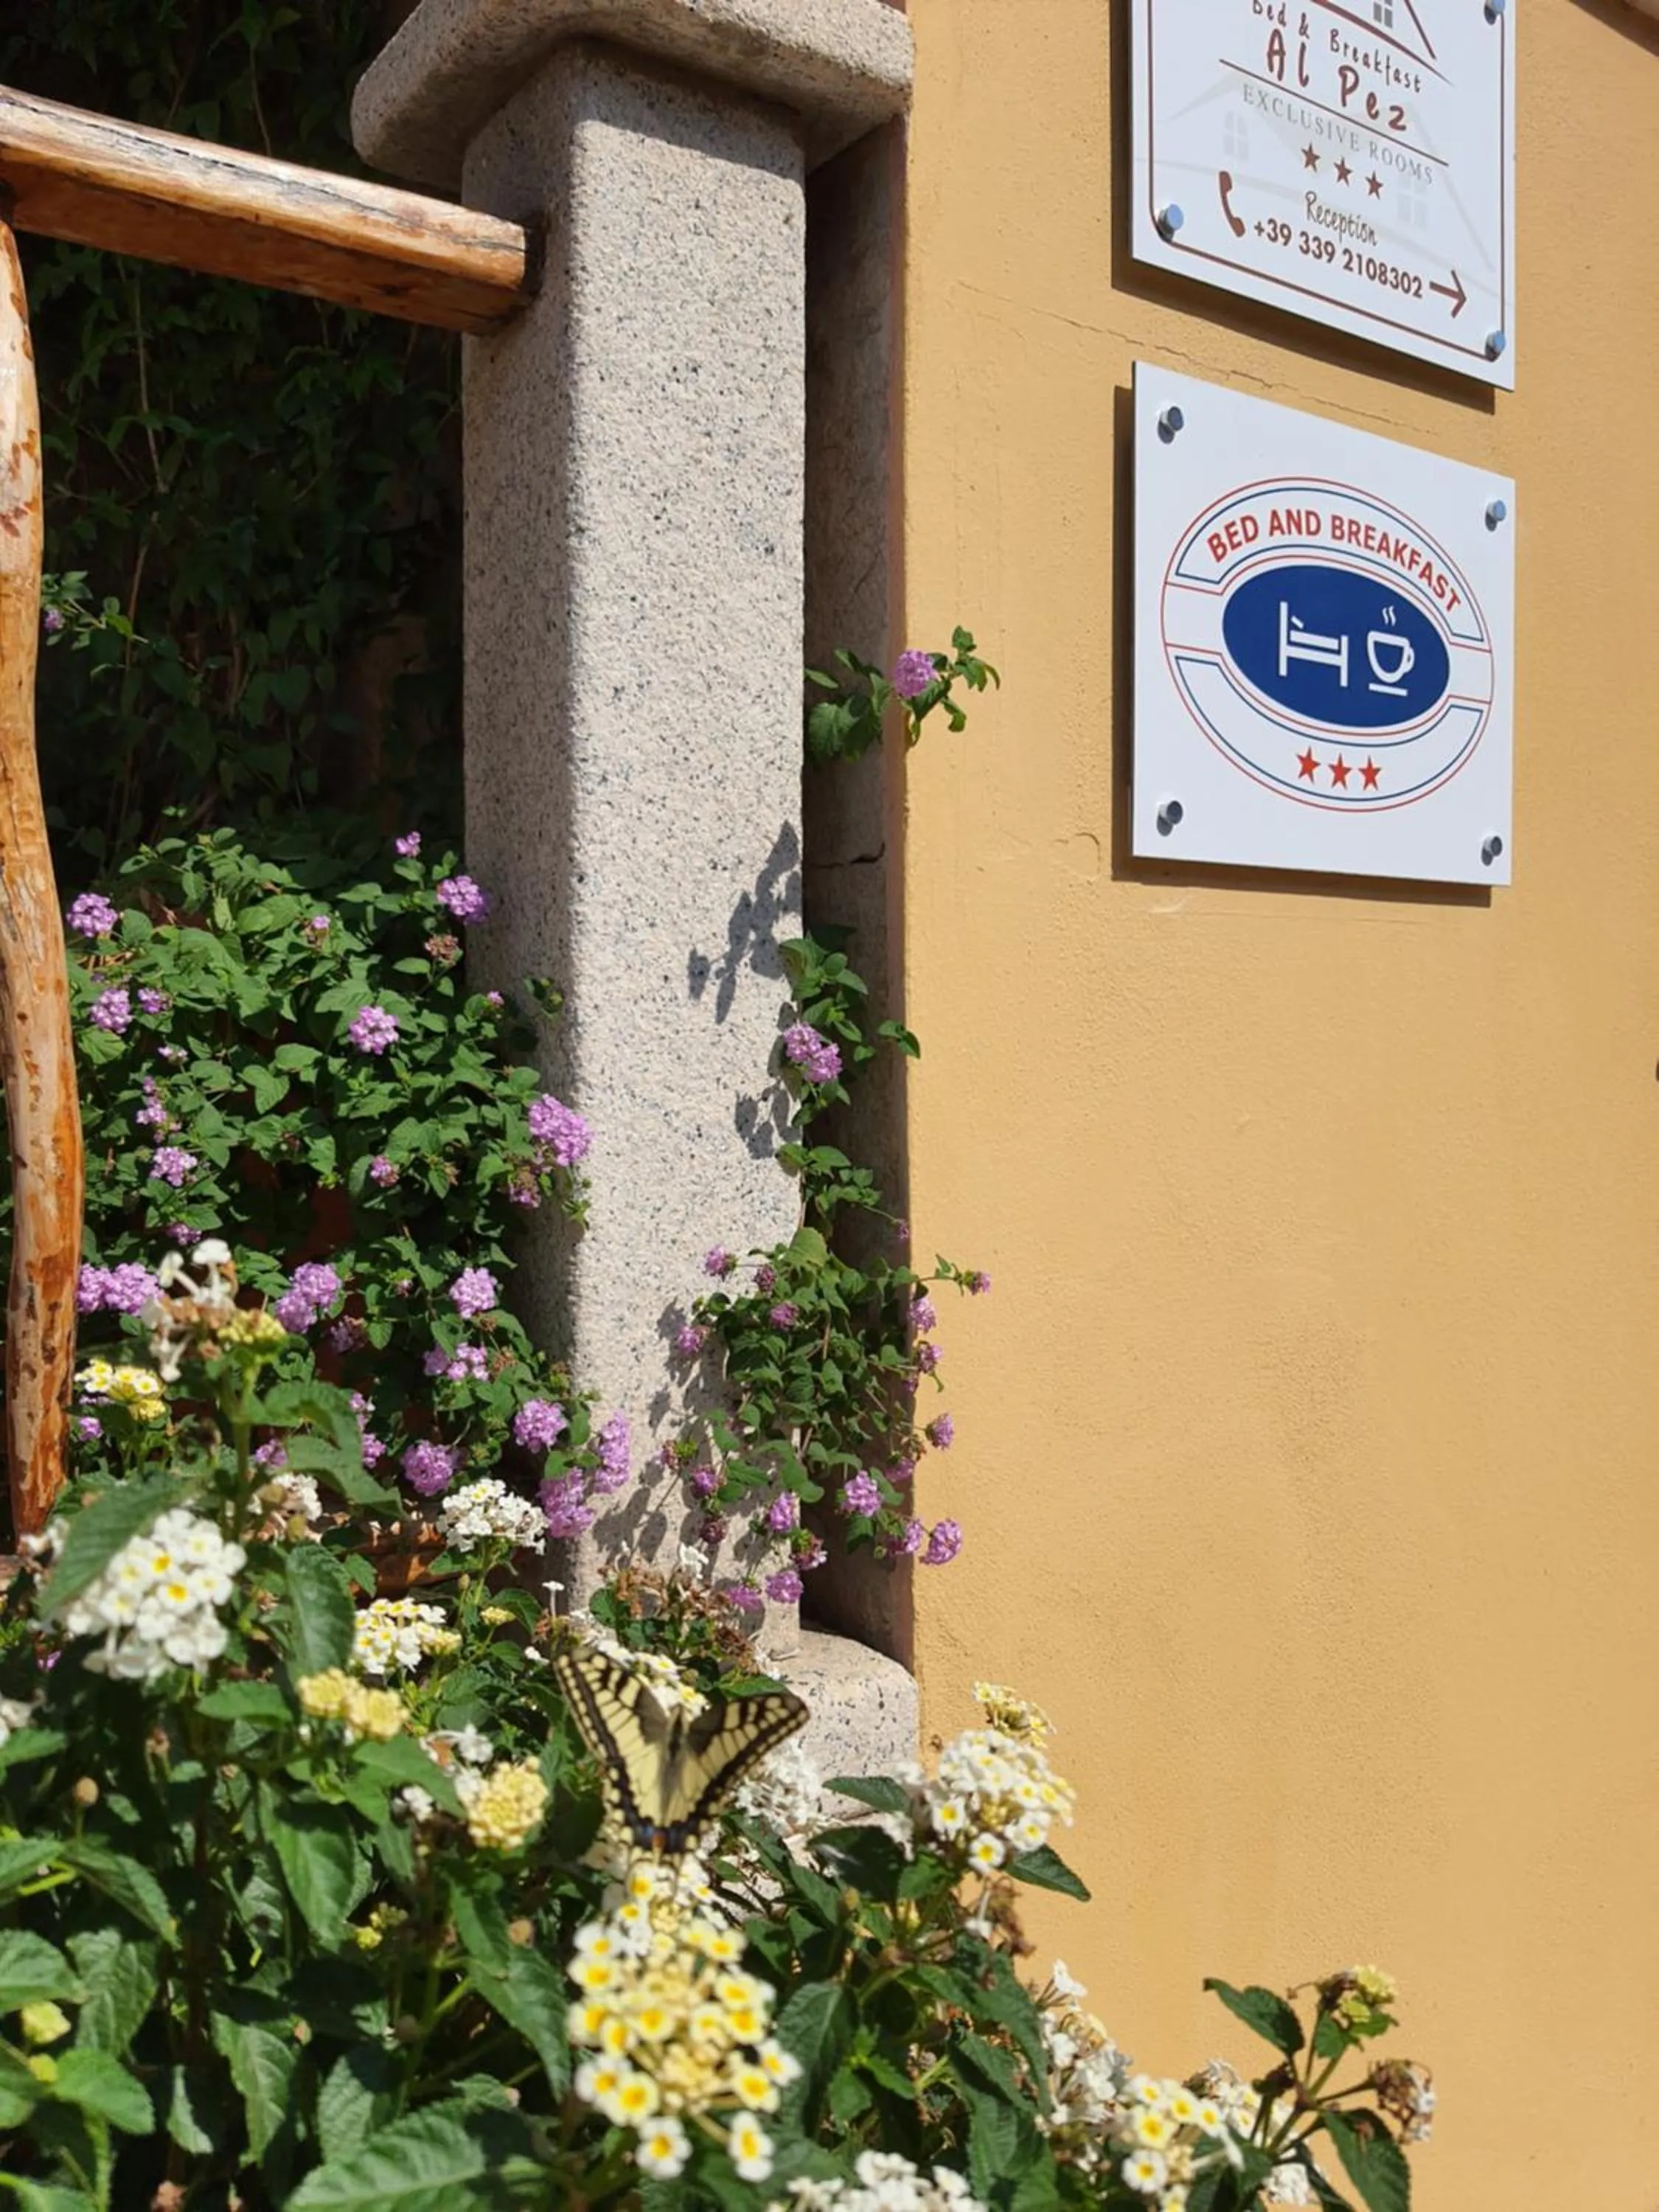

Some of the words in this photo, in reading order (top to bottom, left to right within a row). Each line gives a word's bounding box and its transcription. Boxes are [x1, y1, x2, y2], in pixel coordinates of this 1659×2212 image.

[1267, 28, 1310, 88] Al
[1338, 65, 1407, 131] Pez
[1298, 12, 1310, 39] &
[1329, 28, 1422, 94] Breakfast
[1243, 83, 1360, 152] EXCLUSIVE
[1368, 140, 1433, 184] ROOMS
[1254, 218, 1292, 246] +39
[1298, 231, 1335, 263] 339
[1343, 248, 1422, 299] 2108302
[1305, 191, 1378, 246] Reception
[1207, 515, 1259, 563] BED
[1269, 509, 1321, 538] AND
[1331, 514, 1461, 612] BREAKFAST
